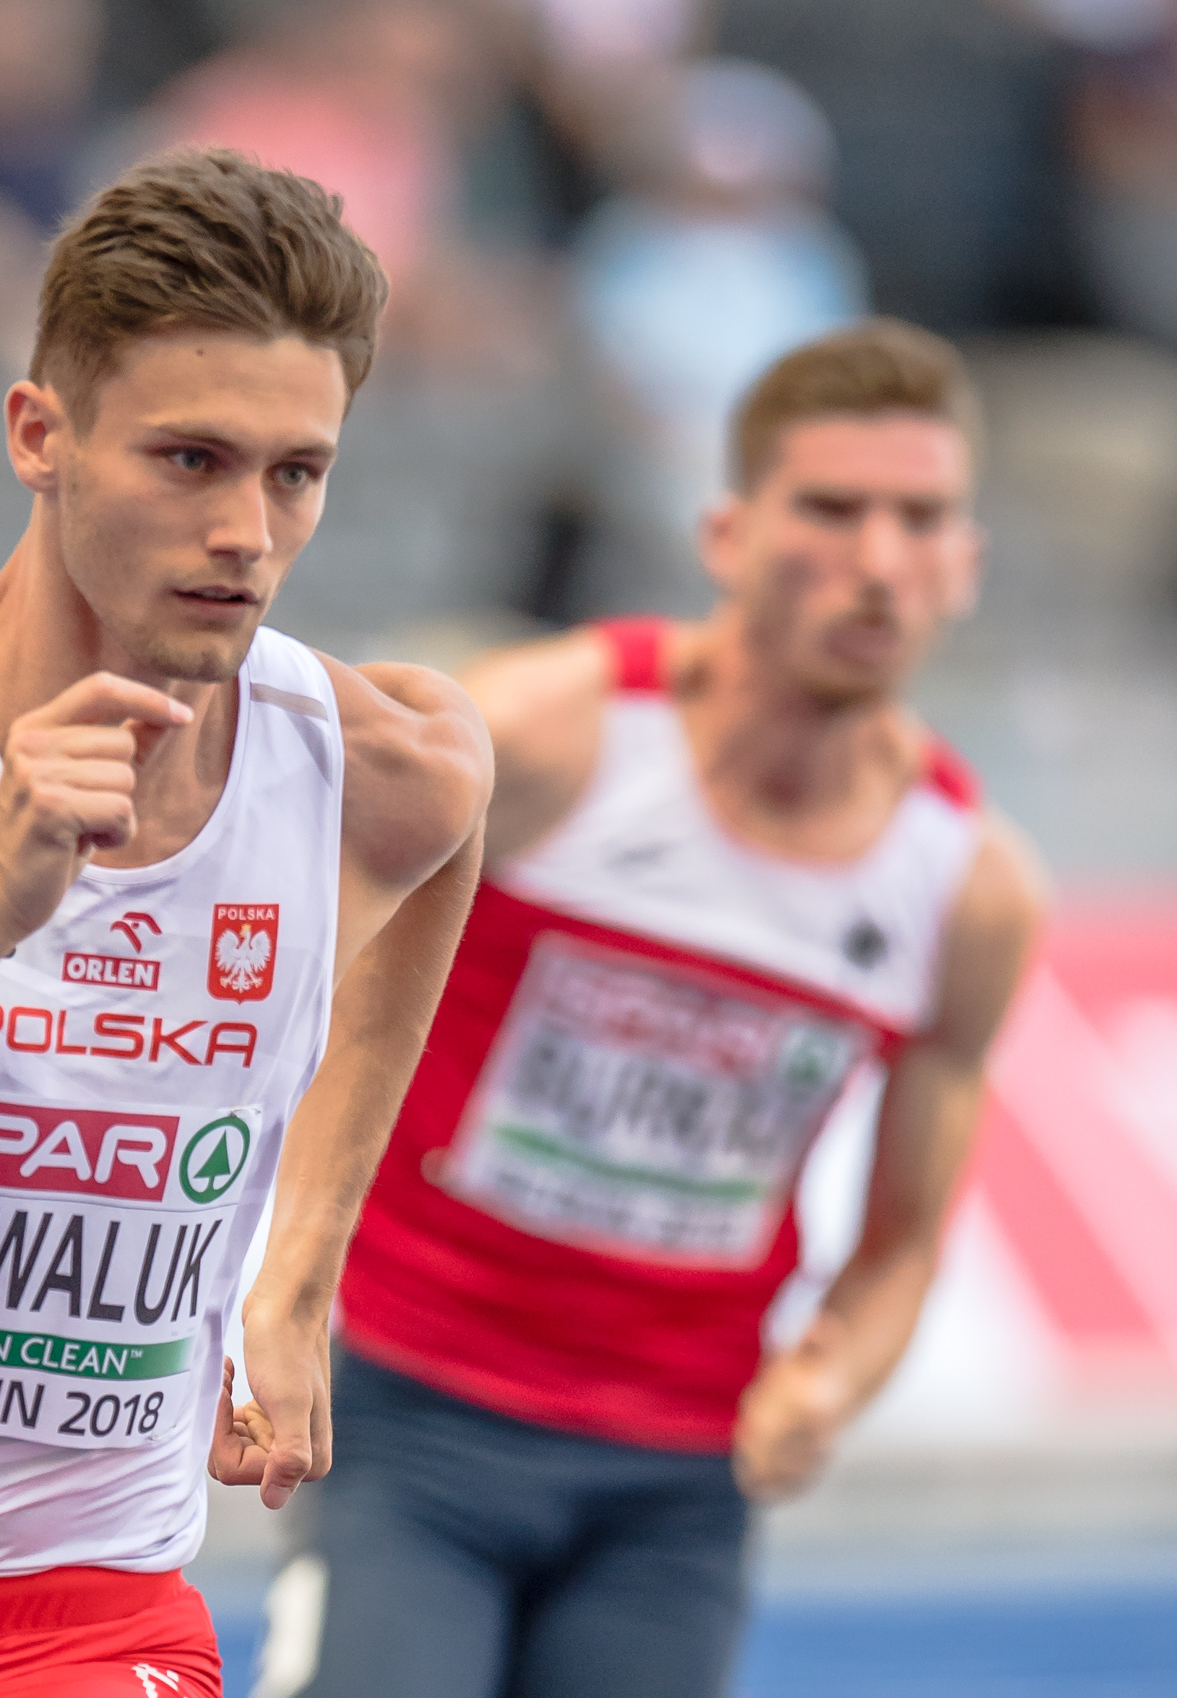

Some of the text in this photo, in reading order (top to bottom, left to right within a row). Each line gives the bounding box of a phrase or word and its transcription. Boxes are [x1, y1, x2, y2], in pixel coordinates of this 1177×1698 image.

[218, 906, 275, 921] POLSKA
[67, 957, 154, 987] ORLEN
[58, 1391, 164, 1437] 2018
